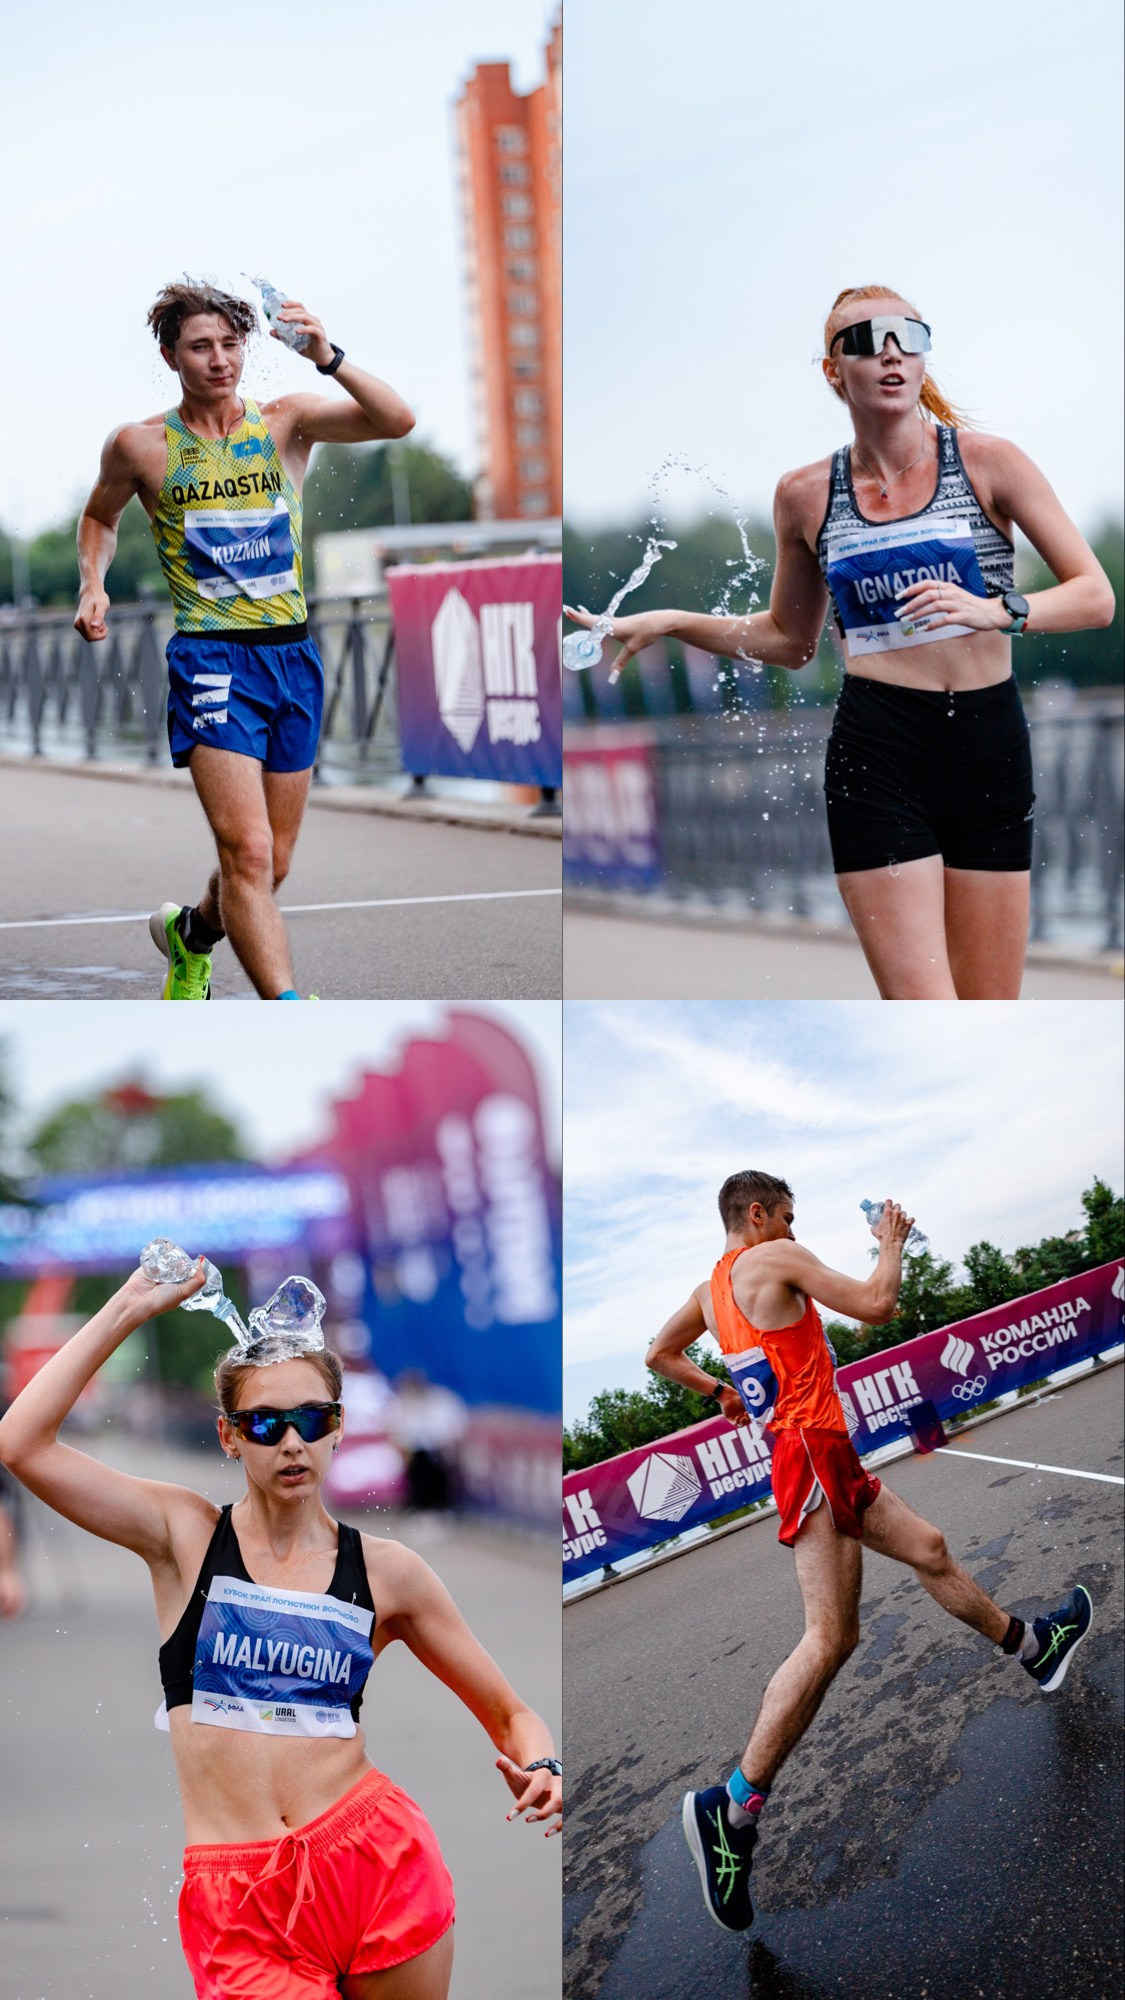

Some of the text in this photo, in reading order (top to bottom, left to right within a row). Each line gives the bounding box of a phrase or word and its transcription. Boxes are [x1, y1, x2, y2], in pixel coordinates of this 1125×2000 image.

[171, 471, 282, 505] QAZAQSTAN
[211, 535, 271, 565] KUZMIN
[854, 561, 963, 605] IGNATOVA
[979, 1296, 1092, 1353] КОМАНДА
[985, 1321, 1079, 1371] РОССИИ
[741, 1376, 767, 1407] 9
[852, 1360, 921, 1415] НГК
[695, 1423, 772, 1481] НГК
[708, 1458, 773, 1500] ресурс
[223, 1587, 359, 1623] КУБОК УРАЛ ЛОГИСТИКИ ВОРОНОВО
[212, 1631, 353, 1685] MALYUGINA
[275, 1707, 297, 1718] URAL
